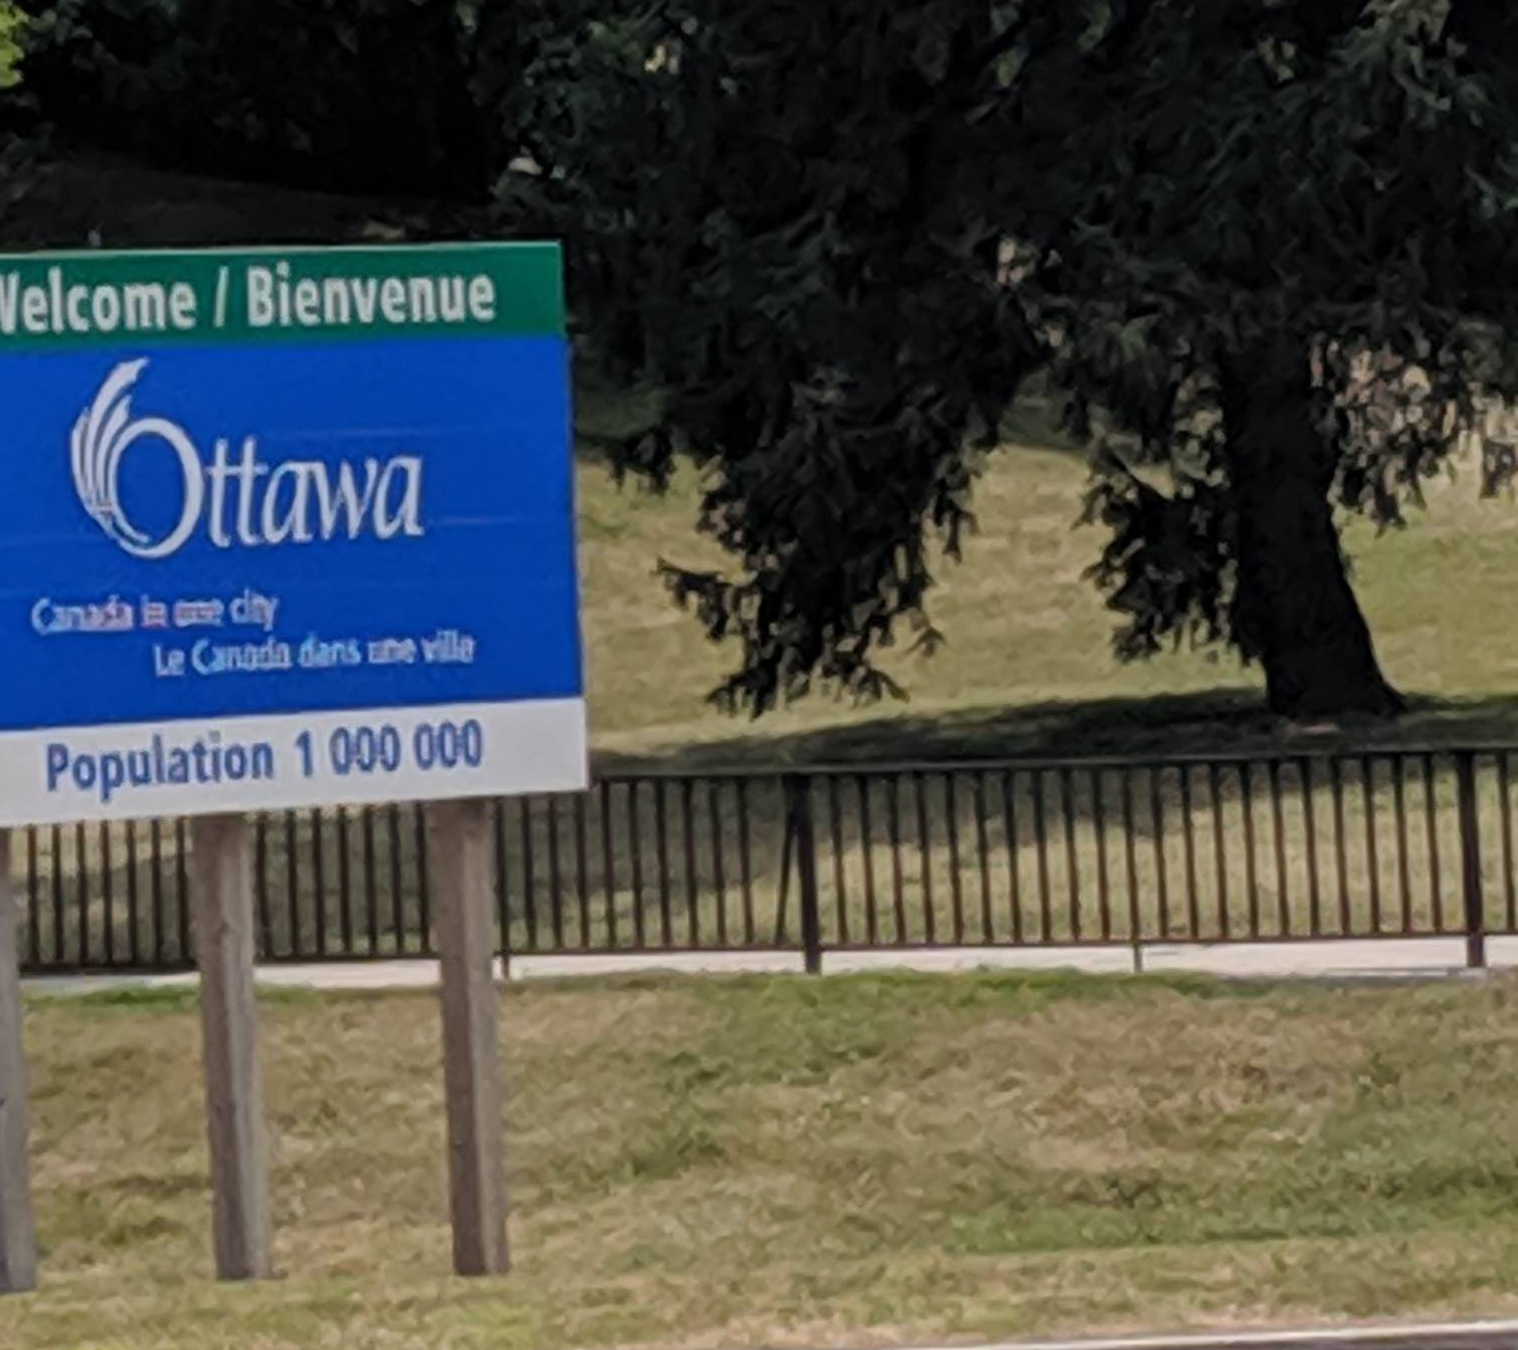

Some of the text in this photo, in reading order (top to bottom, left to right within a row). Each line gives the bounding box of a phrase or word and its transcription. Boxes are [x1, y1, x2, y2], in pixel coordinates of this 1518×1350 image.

[214, 266, 229, 328] /
[246, 261, 496, 328] Bienvenue
[70, 356, 425, 559] Ottawa
[31, 595, 133, 634] Canada
[230, 589, 278, 631] city
[153, 628, 475, 677] Le Canada dans une ville
[46, 718, 483, 802] Population 1 000 000
